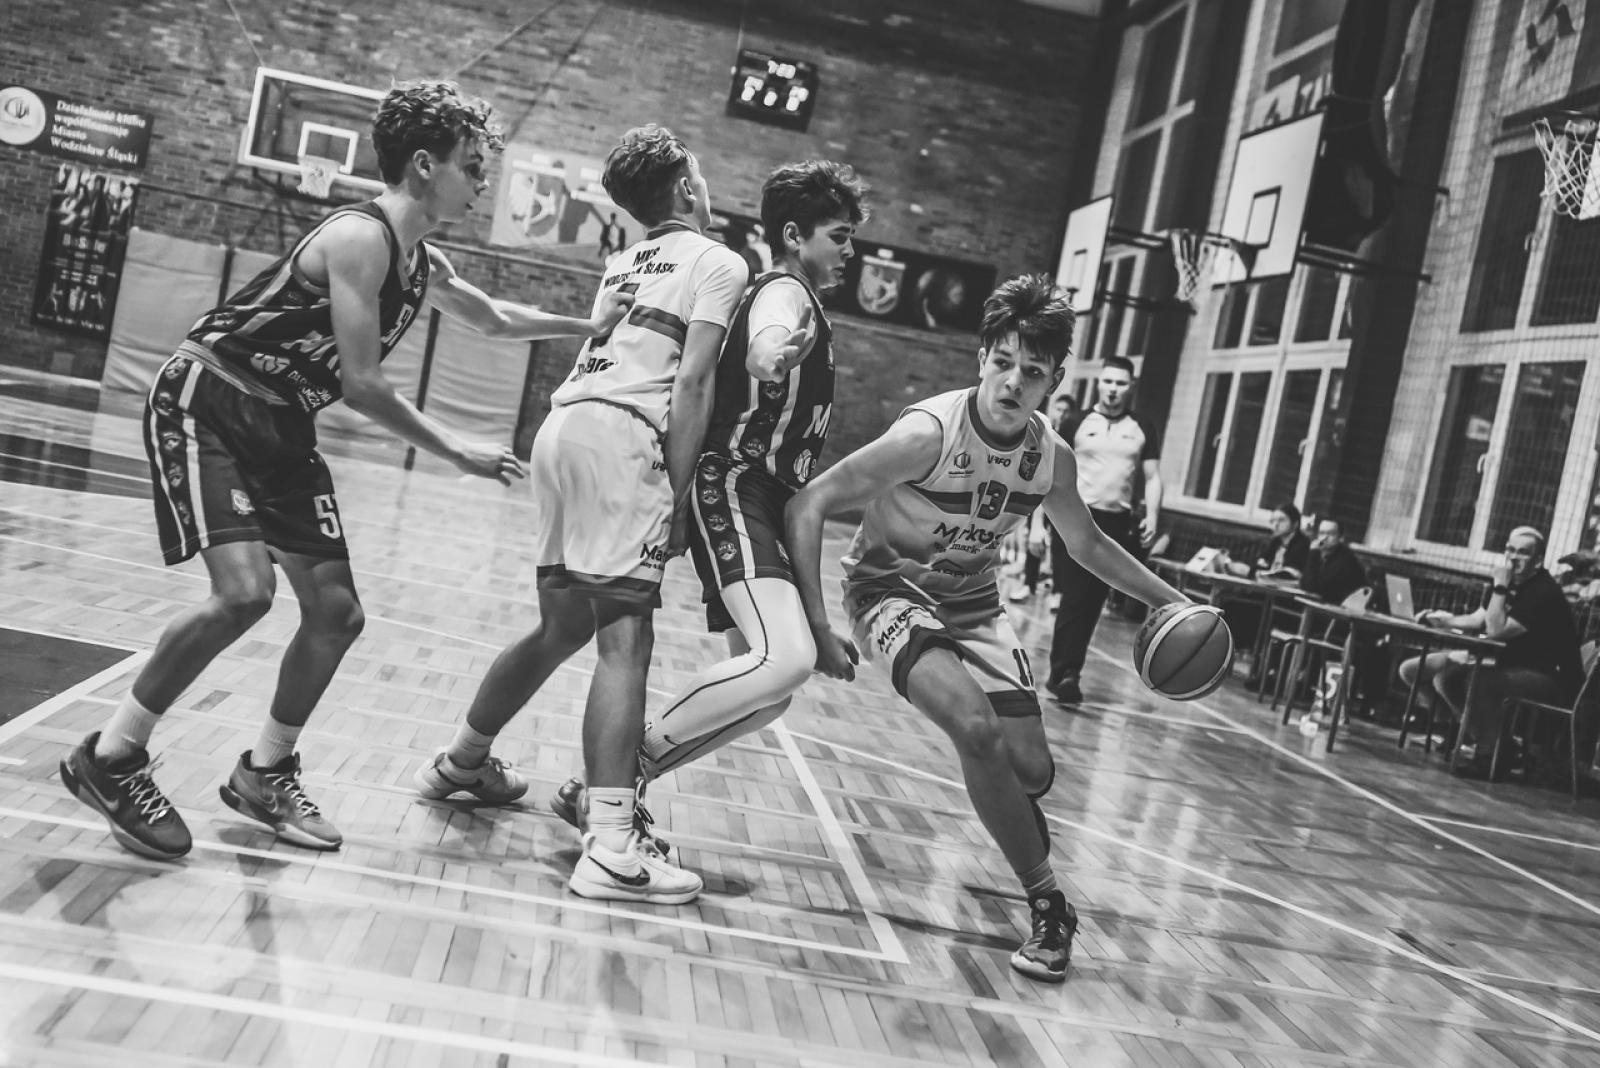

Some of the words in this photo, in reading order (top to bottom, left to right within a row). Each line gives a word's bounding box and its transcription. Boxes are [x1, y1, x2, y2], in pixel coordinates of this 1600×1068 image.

[313, 493, 341, 539] 5
[971, 479, 1009, 520] 13
[1325, 666, 1343, 699] 5
